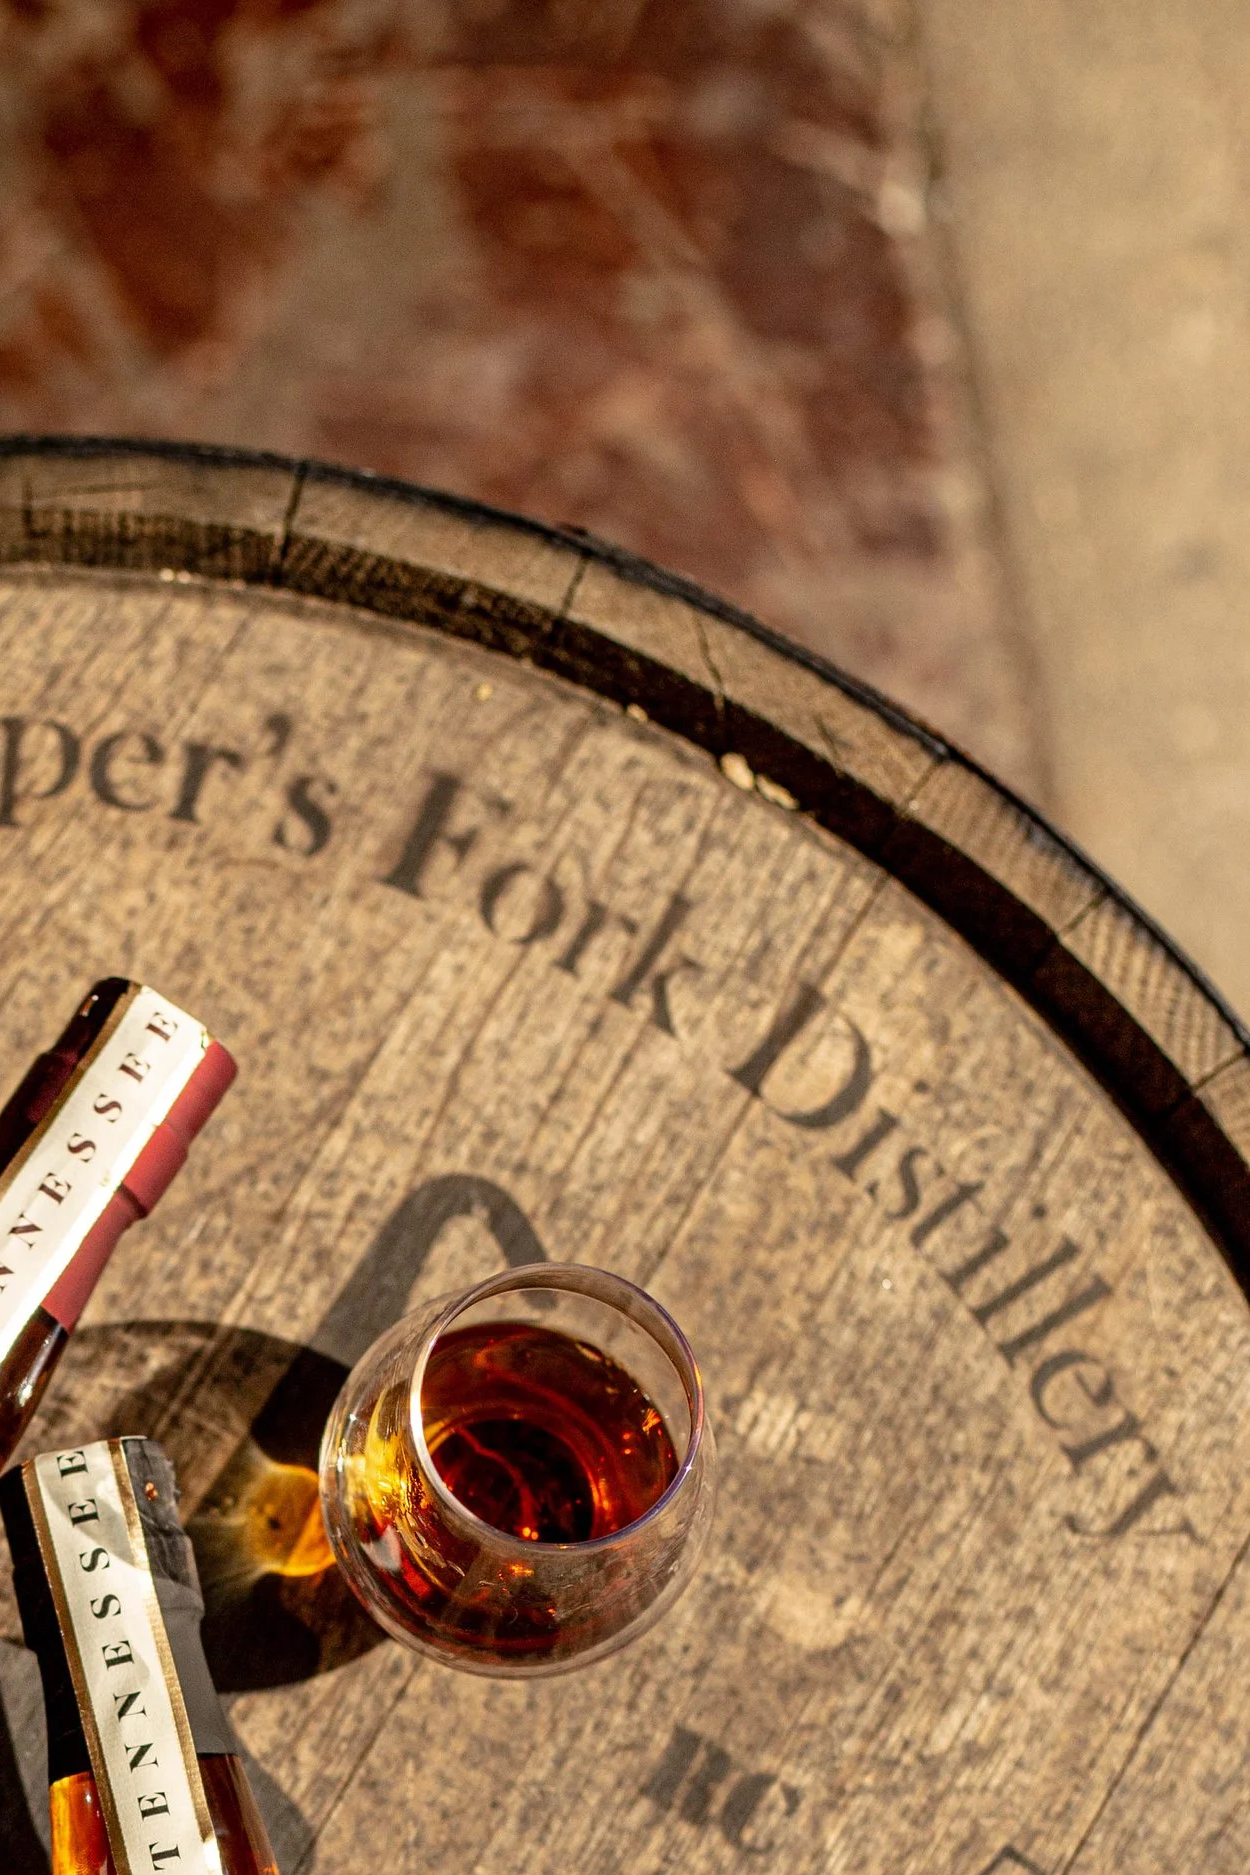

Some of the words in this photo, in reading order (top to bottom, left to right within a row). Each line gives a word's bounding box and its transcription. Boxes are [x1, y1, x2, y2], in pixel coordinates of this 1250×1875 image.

[383, 770, 702, 1040] Fork
[729, 985, 1202, 1552] Distillery
[56, 1448, 181, 1870] TENNESSEE
